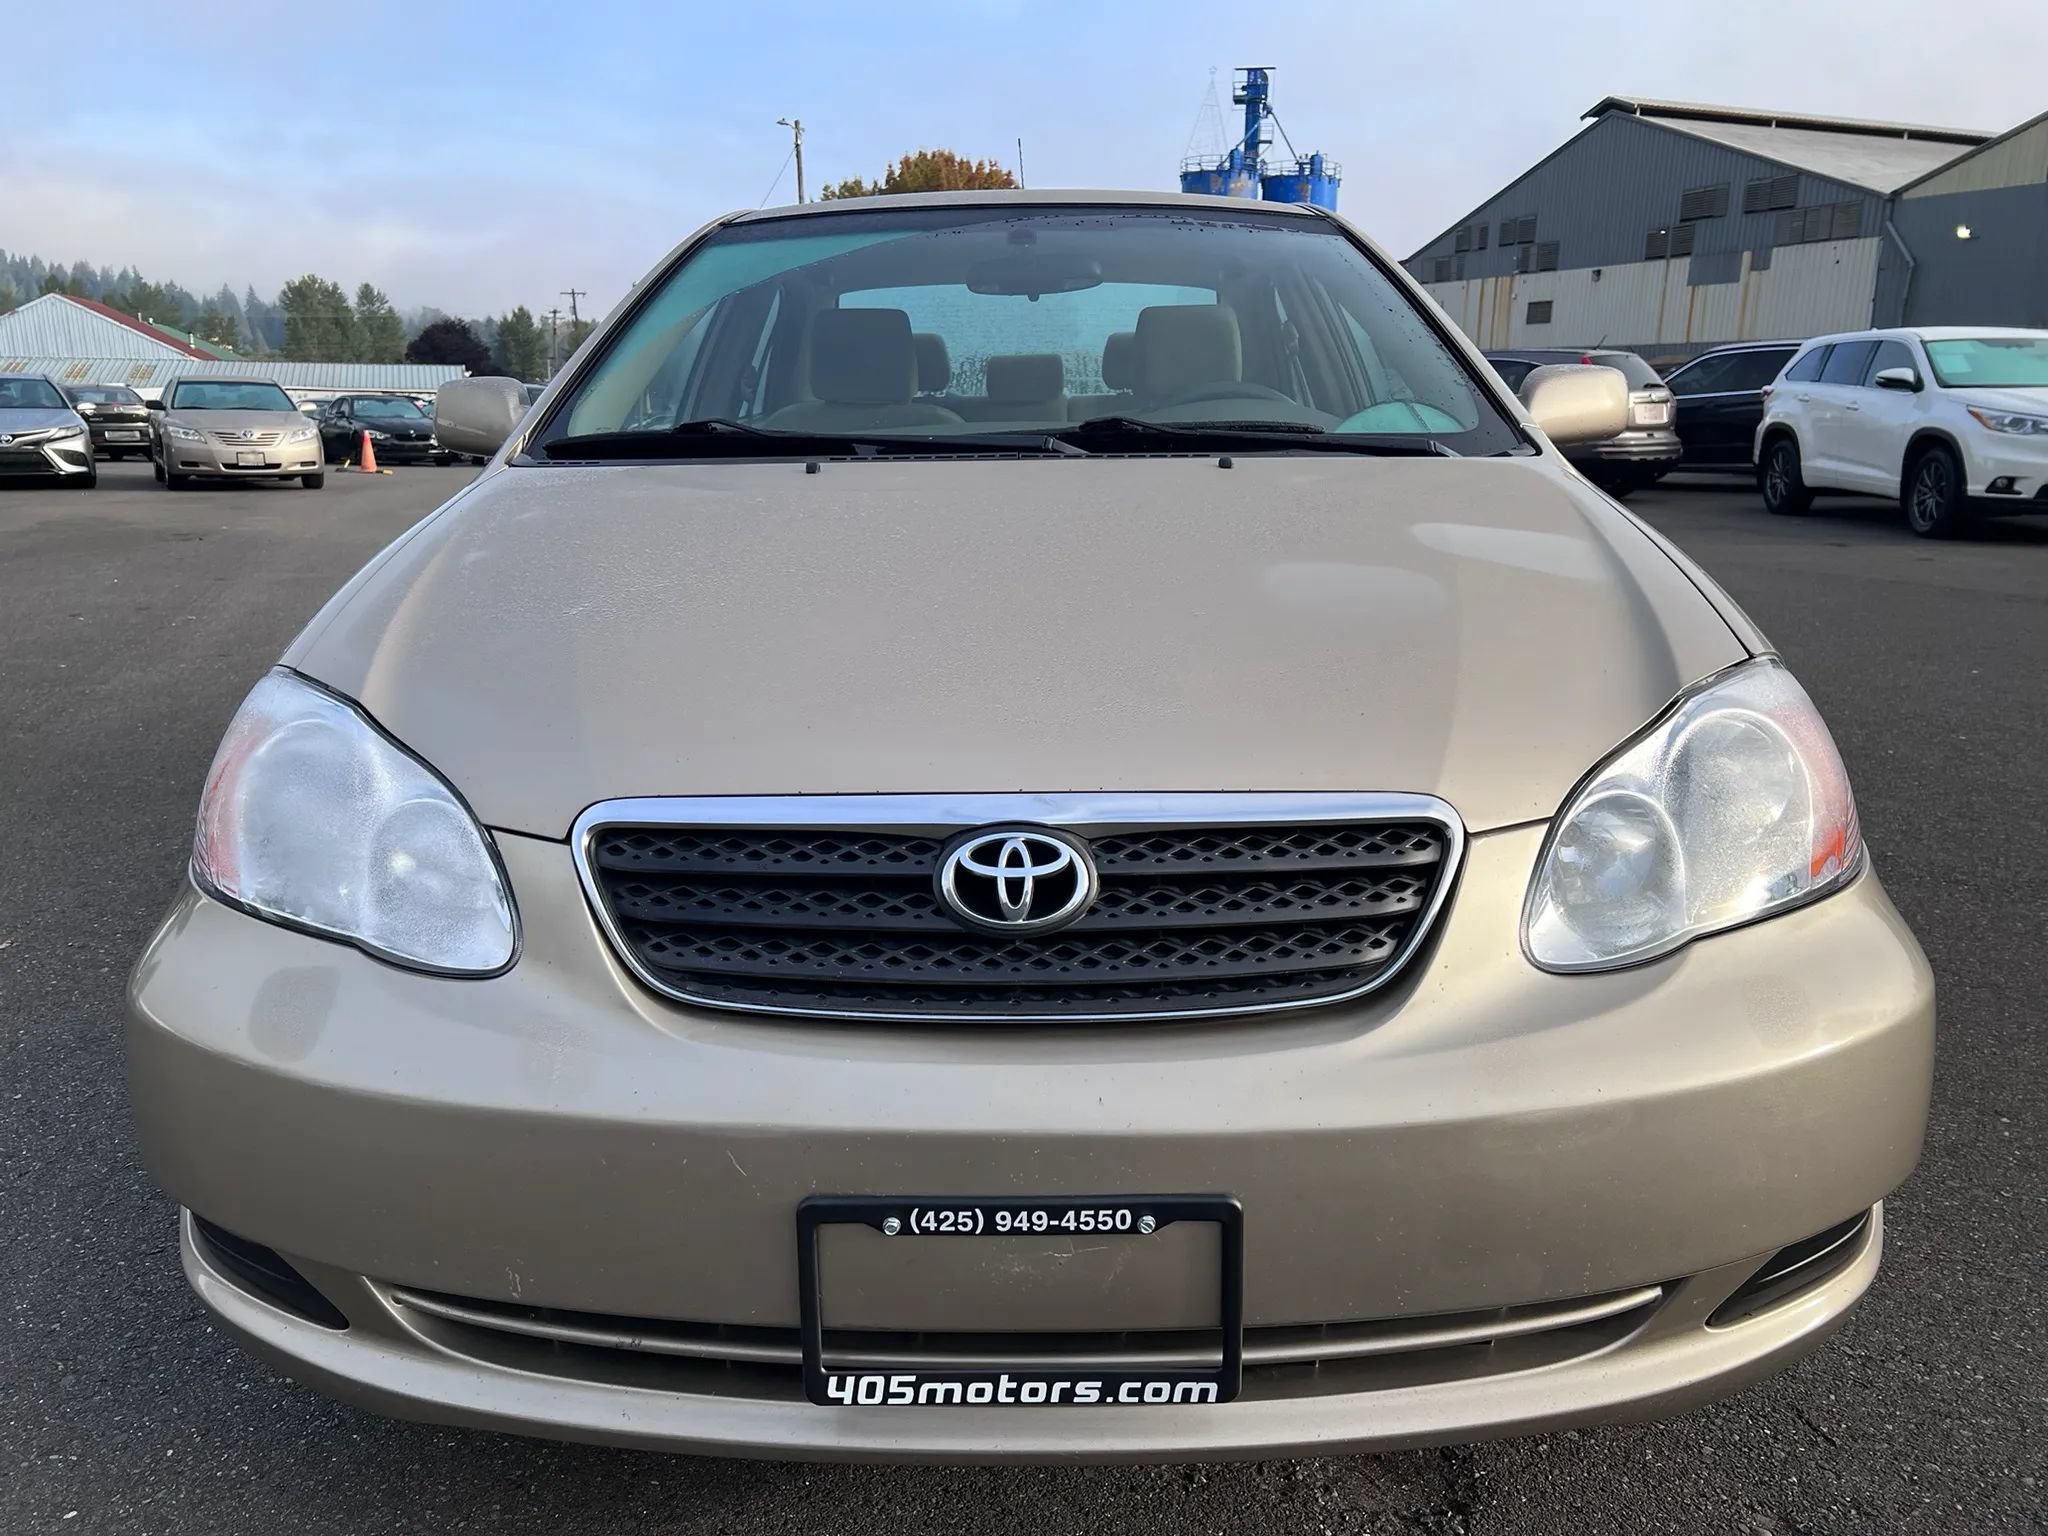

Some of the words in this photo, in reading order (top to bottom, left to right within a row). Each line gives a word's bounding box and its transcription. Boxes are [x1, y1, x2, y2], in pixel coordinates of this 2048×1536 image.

[909, 1208, 984, 1234] (425)
[996, 1208, 1132, 1232] 949-4550
[827, 1374, 1218, 1405] 405motors.com
